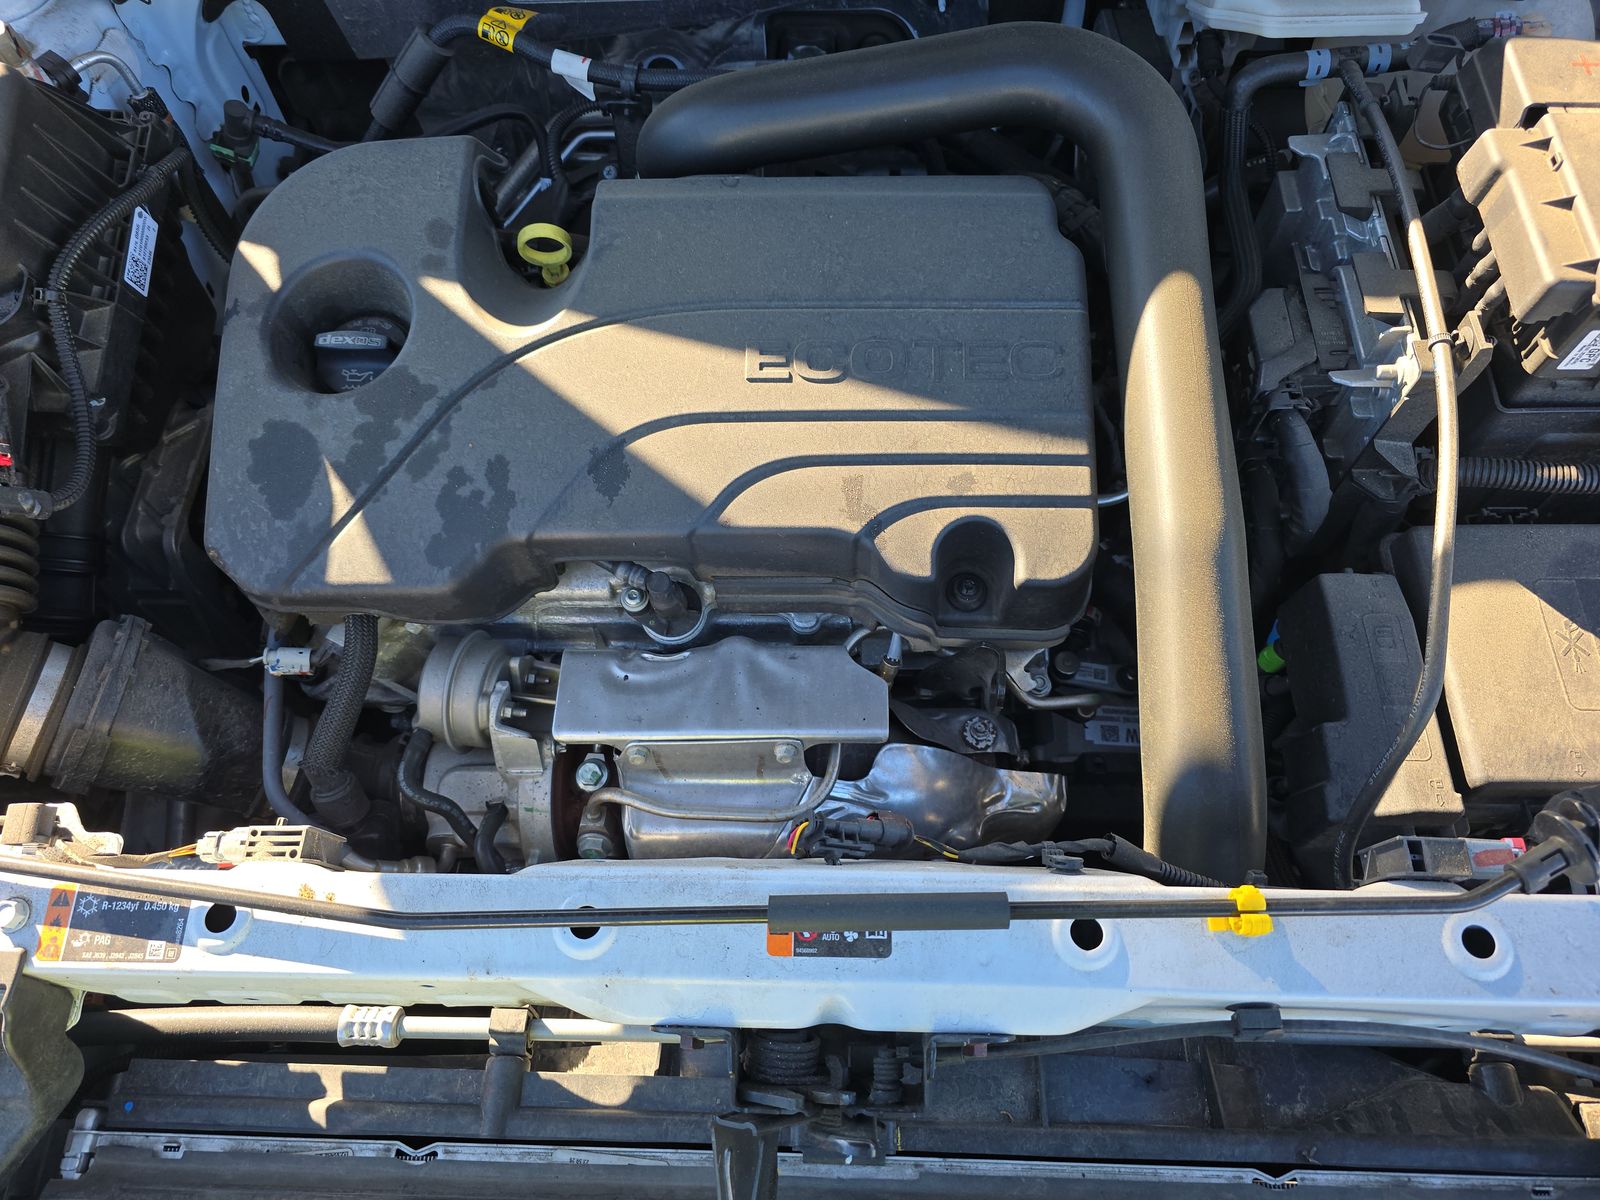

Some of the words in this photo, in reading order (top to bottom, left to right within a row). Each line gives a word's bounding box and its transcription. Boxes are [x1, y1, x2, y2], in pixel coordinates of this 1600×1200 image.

[318, 335, 382, 347] dexos
[745, 339, 1063, 384] ECOTEC
[102, 901, 139, 912] R-1234yf
[144, 901, 167, 911] 0.450
[168, 902, 179, 912] kg
[94, 935, 112, 945] PAG
[822, 933, 840, 941] AUTO
